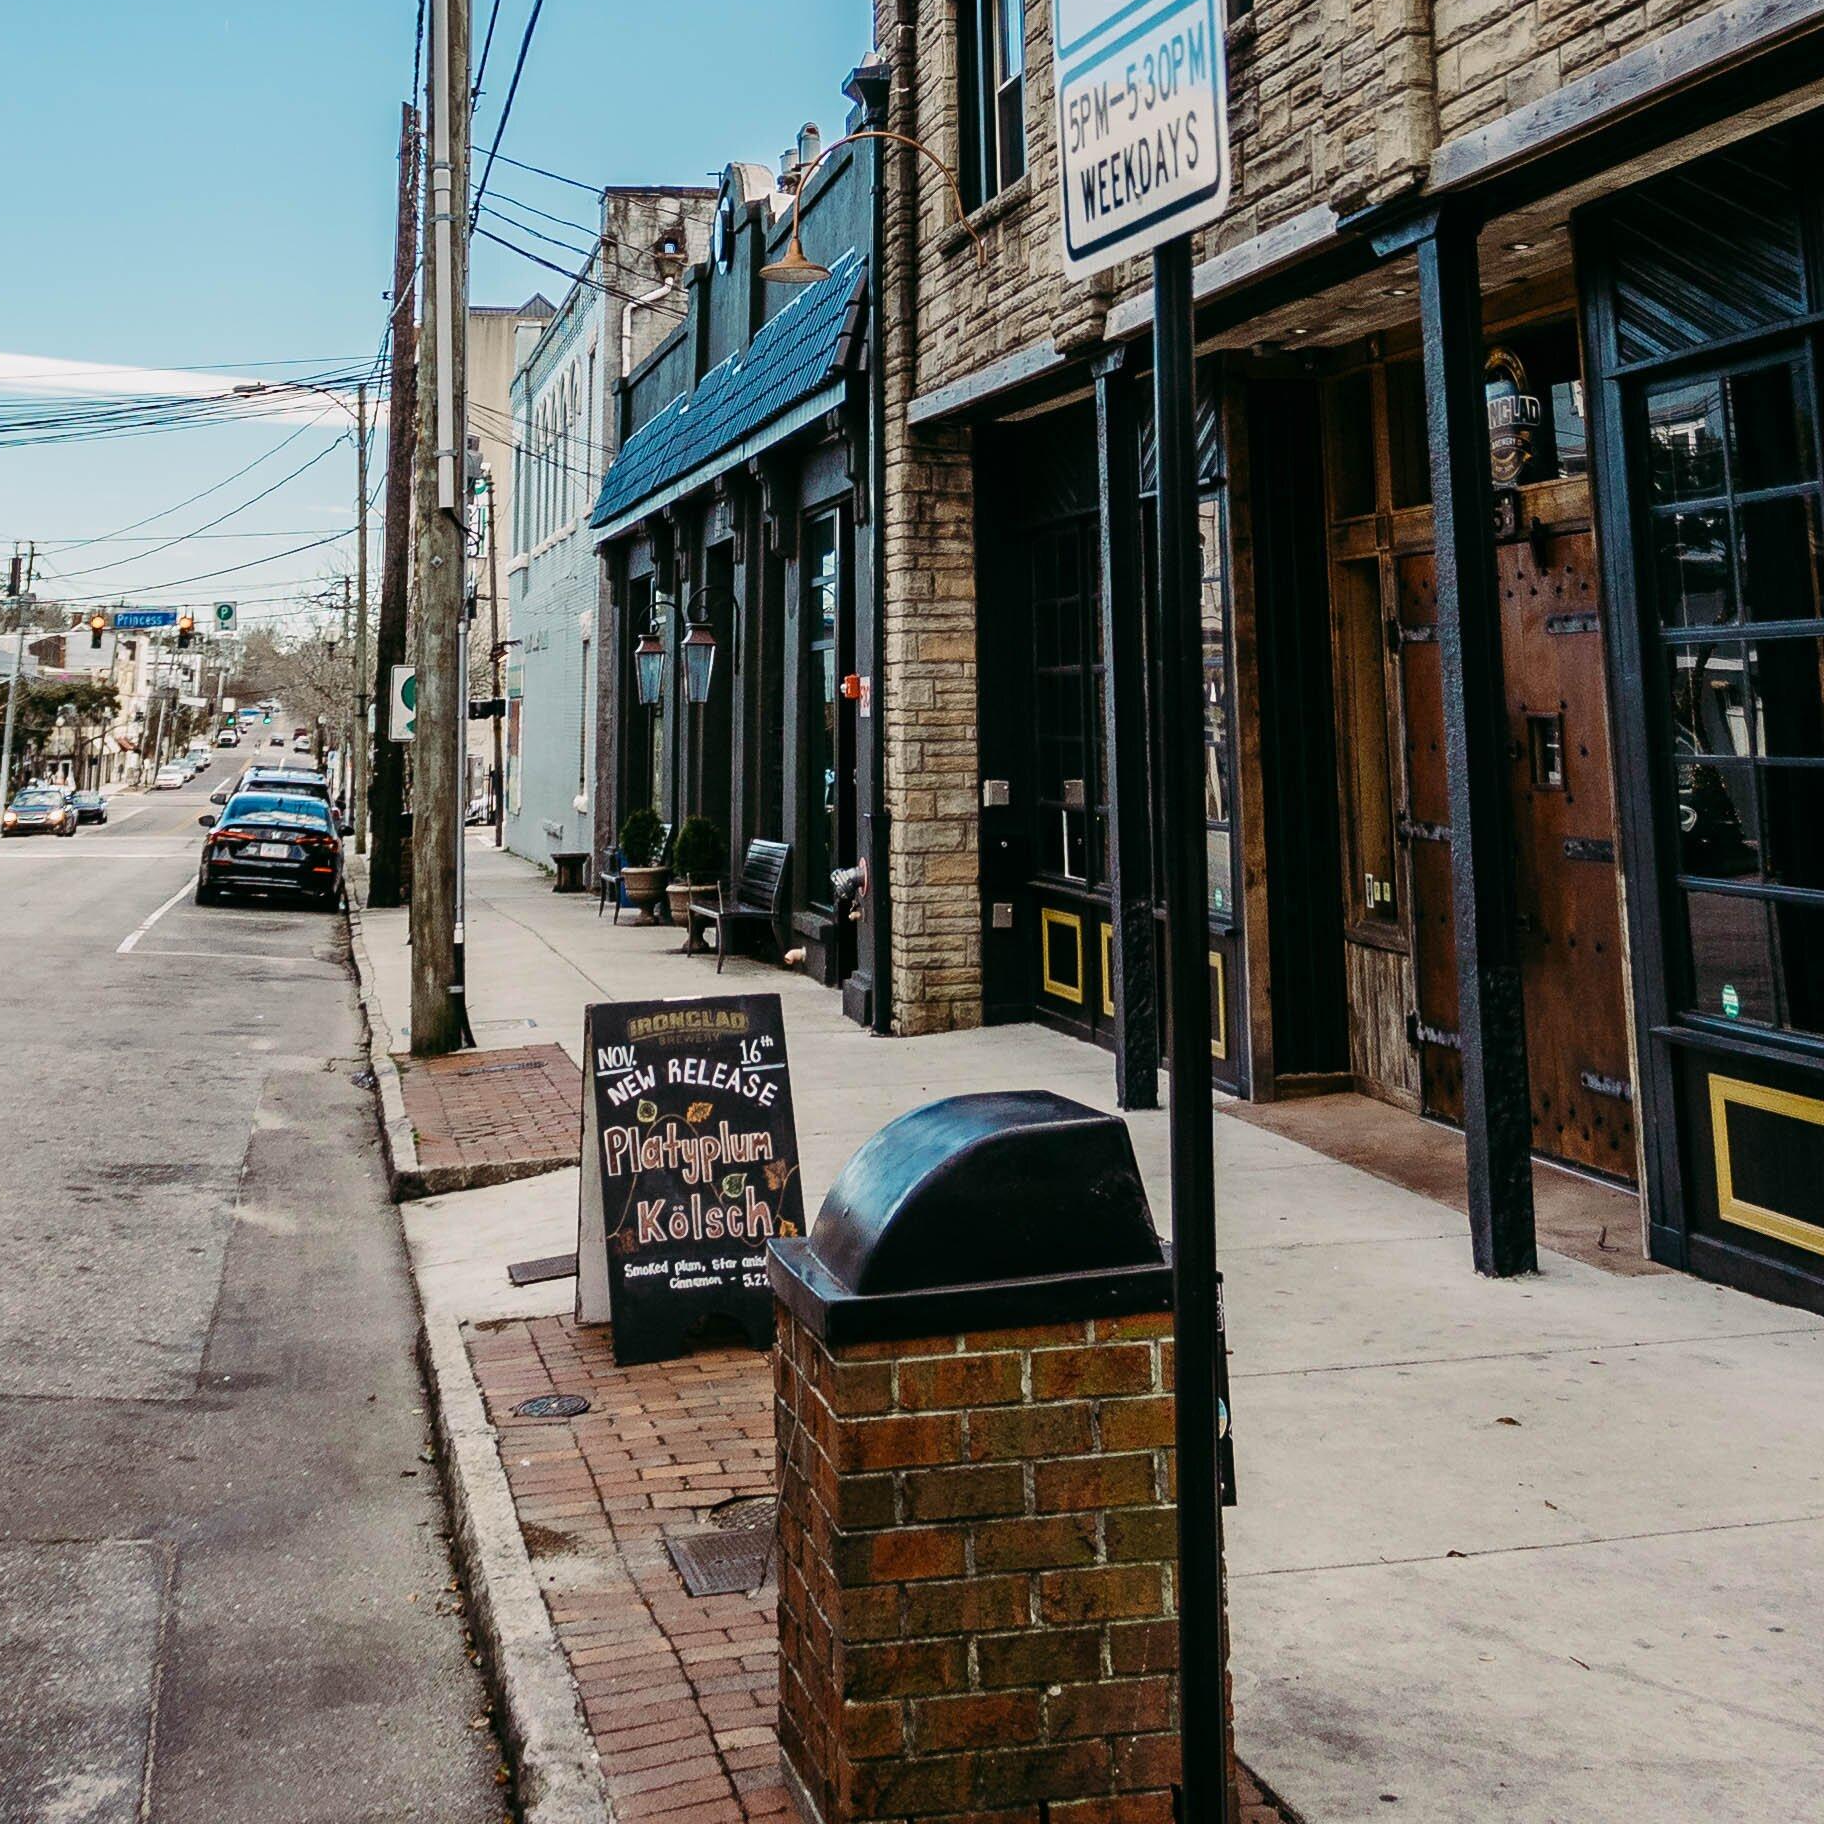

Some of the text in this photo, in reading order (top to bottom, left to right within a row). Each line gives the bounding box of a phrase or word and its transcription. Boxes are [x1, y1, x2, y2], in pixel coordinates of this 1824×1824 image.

[1081, 110, 1198, 223] WEEKDAYS
[117, 614, 163, 626] Princess
[629, 1010, 747, 1039] IRONCLAD
[597, 1044, 637, 1071] NOV.
[607, 1057, 778, 1107] NEW RELEASE
[603, 1121, 774, 1184] Platyplum
[636, 1185, 774, 1243] Kölsch
[674, 1259, 706, 1276] plum,
